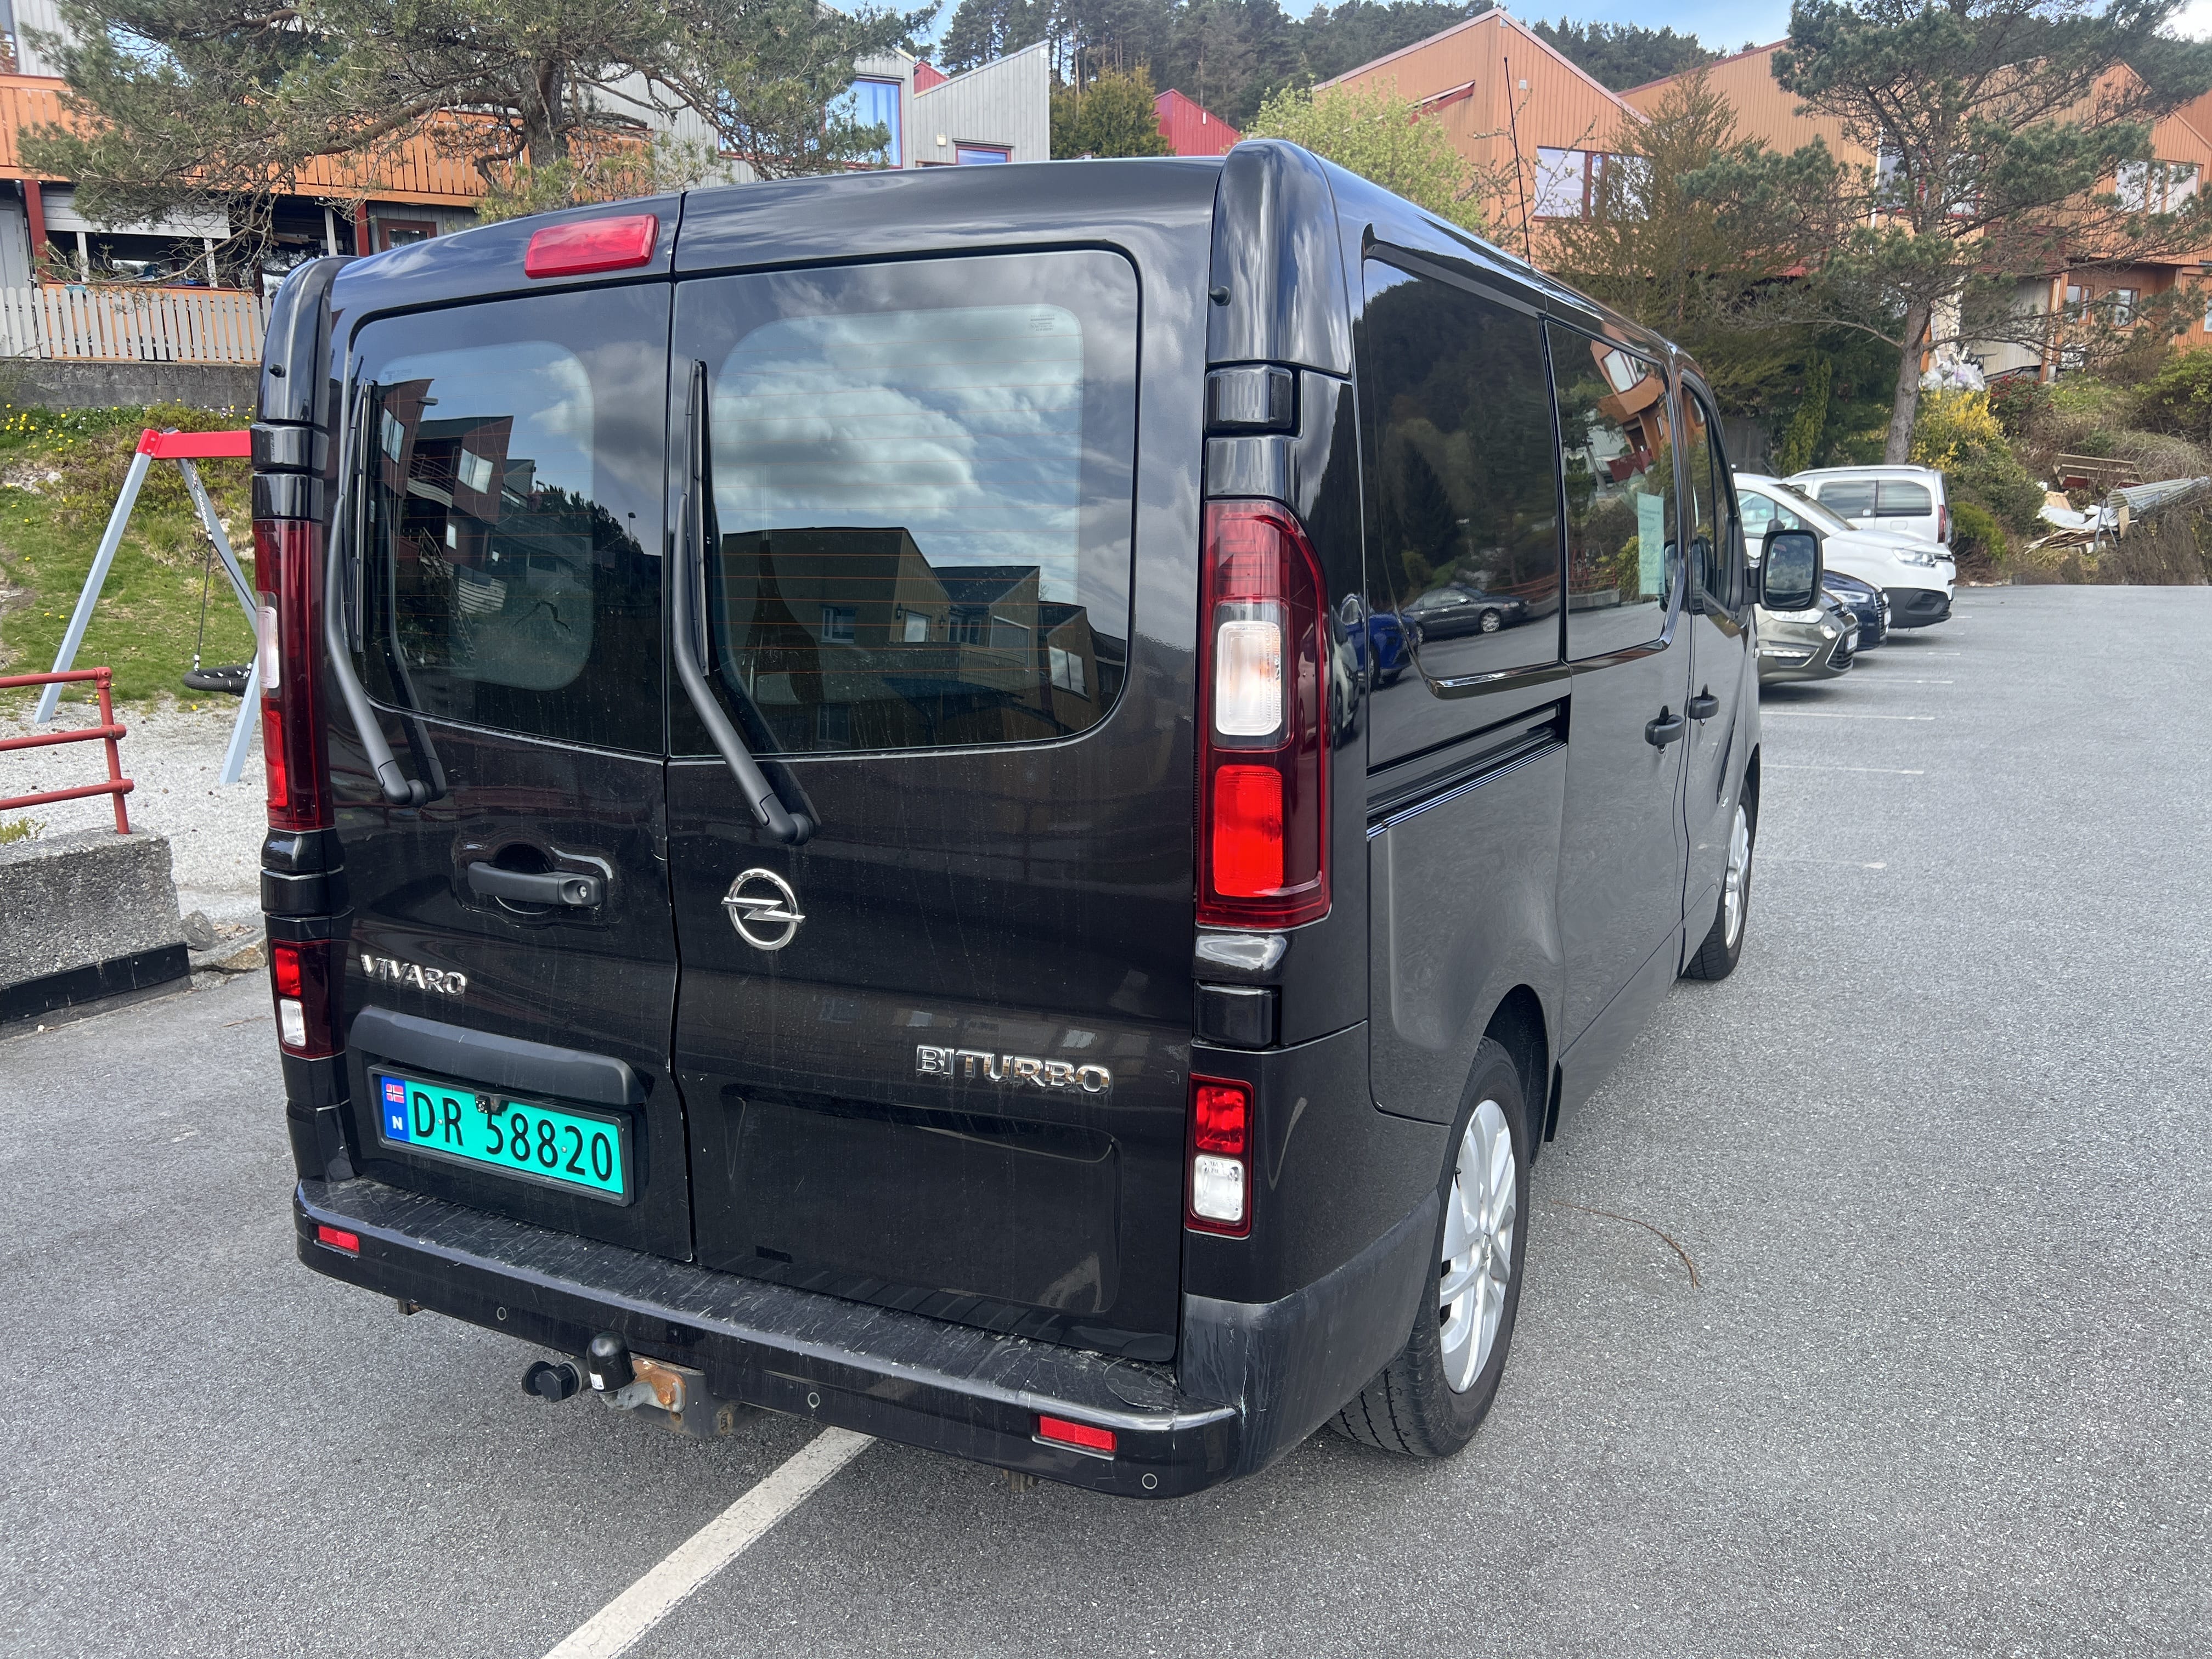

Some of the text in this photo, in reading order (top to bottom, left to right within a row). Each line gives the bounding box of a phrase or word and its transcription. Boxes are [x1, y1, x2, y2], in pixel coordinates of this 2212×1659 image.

[360, 953, 467, 996] VIVARO
[916, 1044, 1114, 1095] BITURBO
[392, 1115, 403, 1131] N
[413, 1091, 613, 1182] DR 58820
